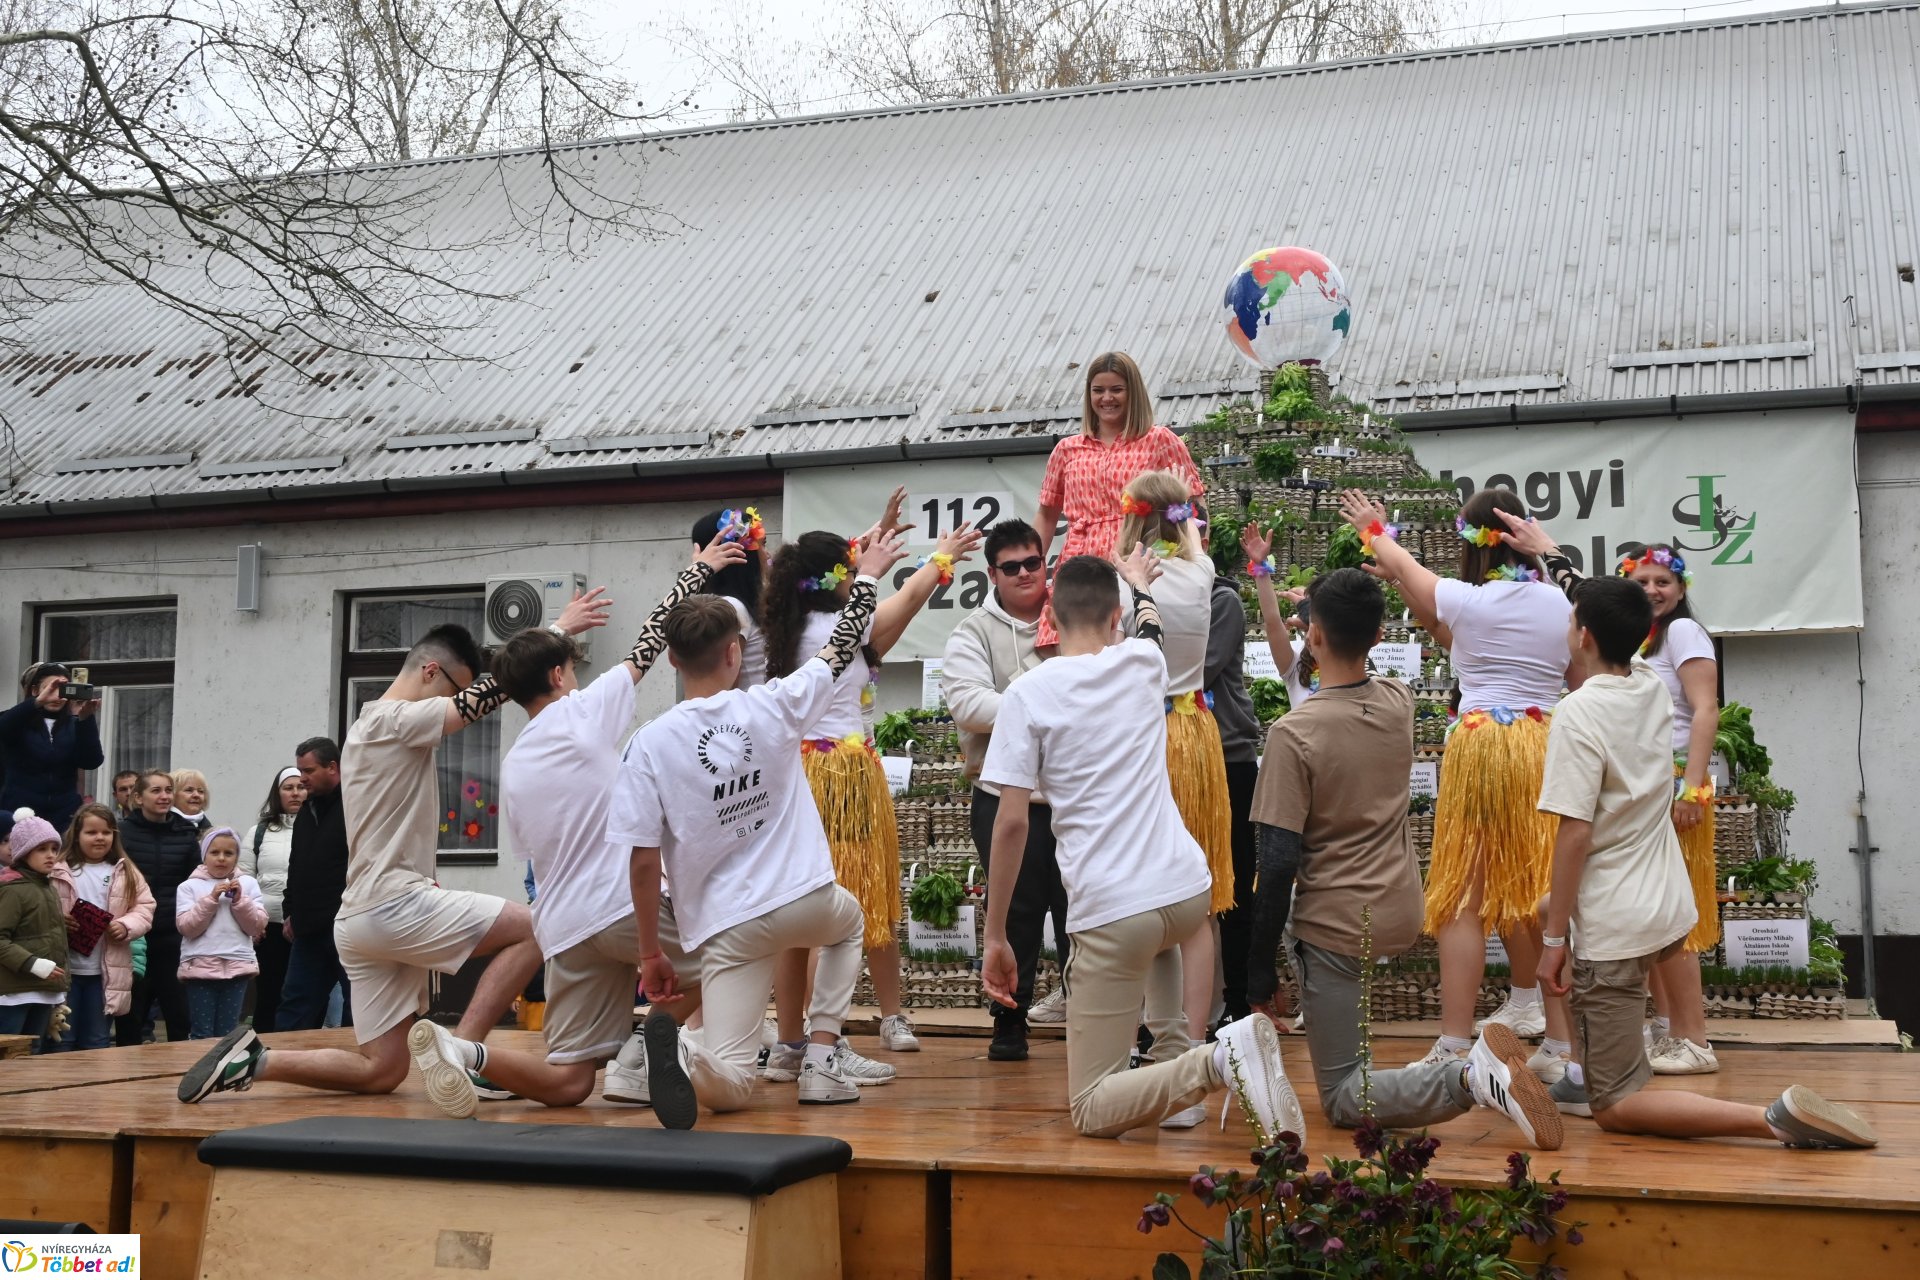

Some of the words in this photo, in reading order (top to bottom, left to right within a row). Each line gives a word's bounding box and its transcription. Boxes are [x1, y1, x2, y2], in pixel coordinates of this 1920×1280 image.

[922, 496, 1000, 539] 112
[713, 769, 761, 801] NIKE
[915, 932, 942, 940] Általános
